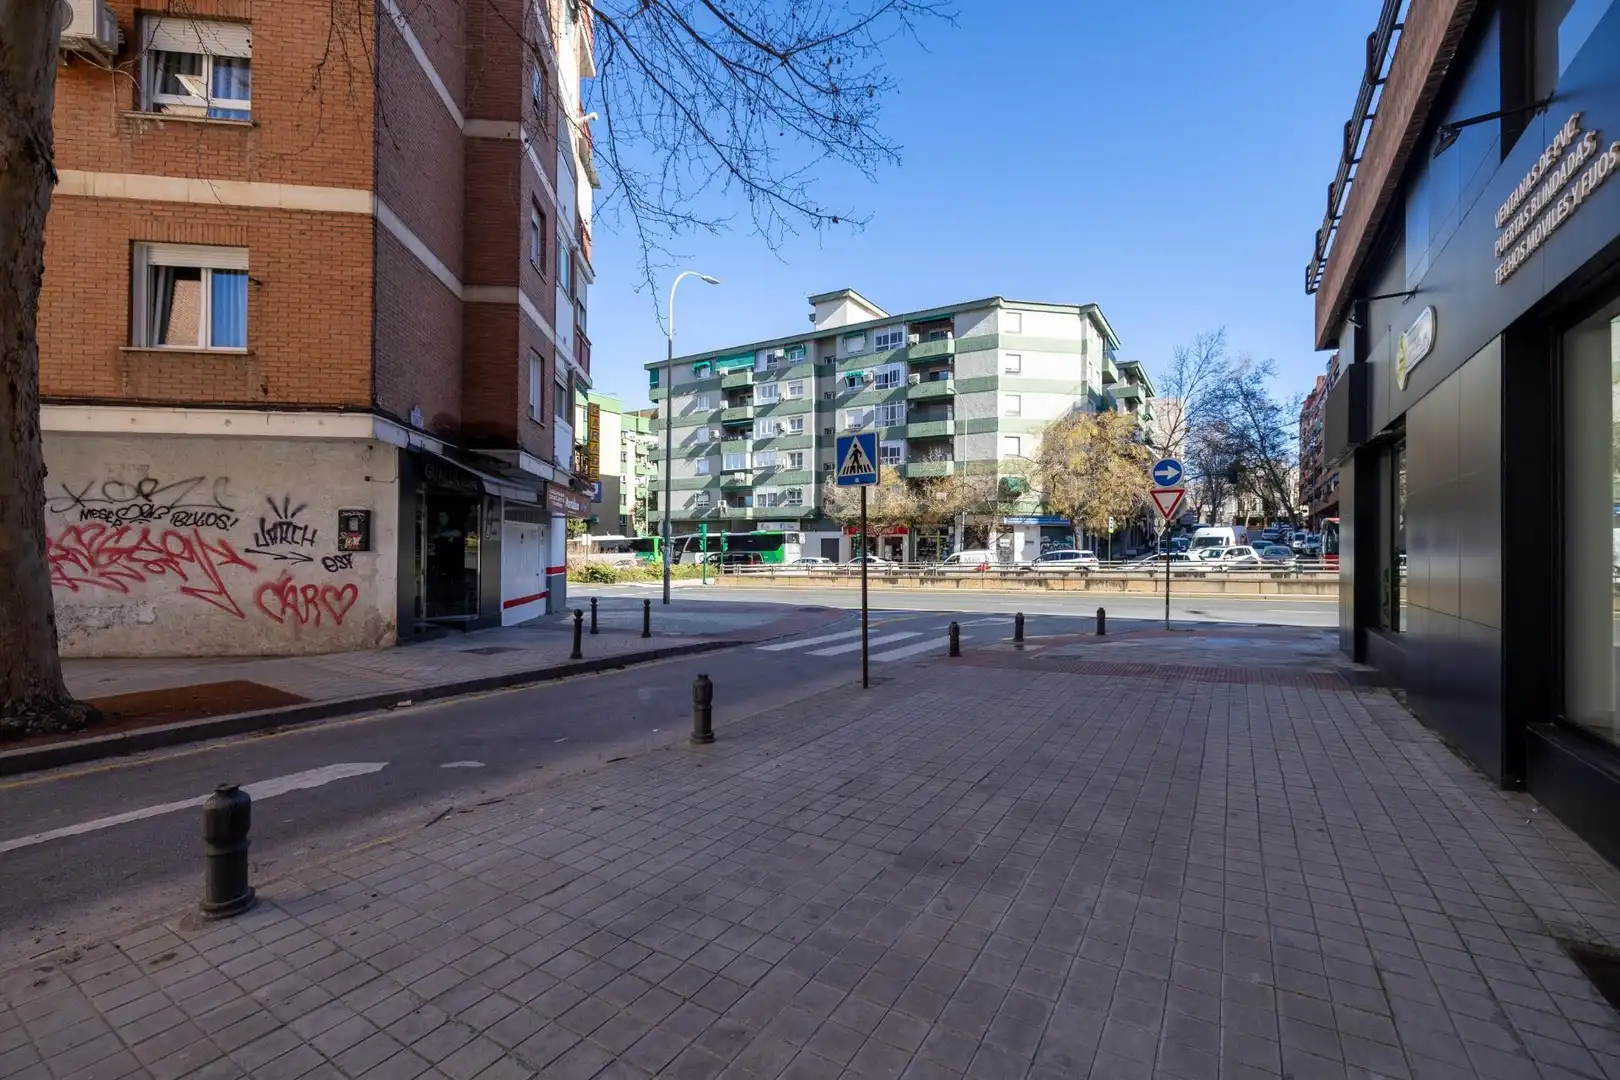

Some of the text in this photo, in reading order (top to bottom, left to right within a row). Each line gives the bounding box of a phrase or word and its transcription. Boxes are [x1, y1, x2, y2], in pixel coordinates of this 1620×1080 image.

[1495, 112, 1580, 229] VENTANAS DE PVC
[1495, 130, 1597, 257] PUERTAS BLINDADAS
[1495, 241, 1527, 285] TECHOS
[1526, 193, 1571, 256] MOVILES
[1571, 181, 1582, 206] Y
